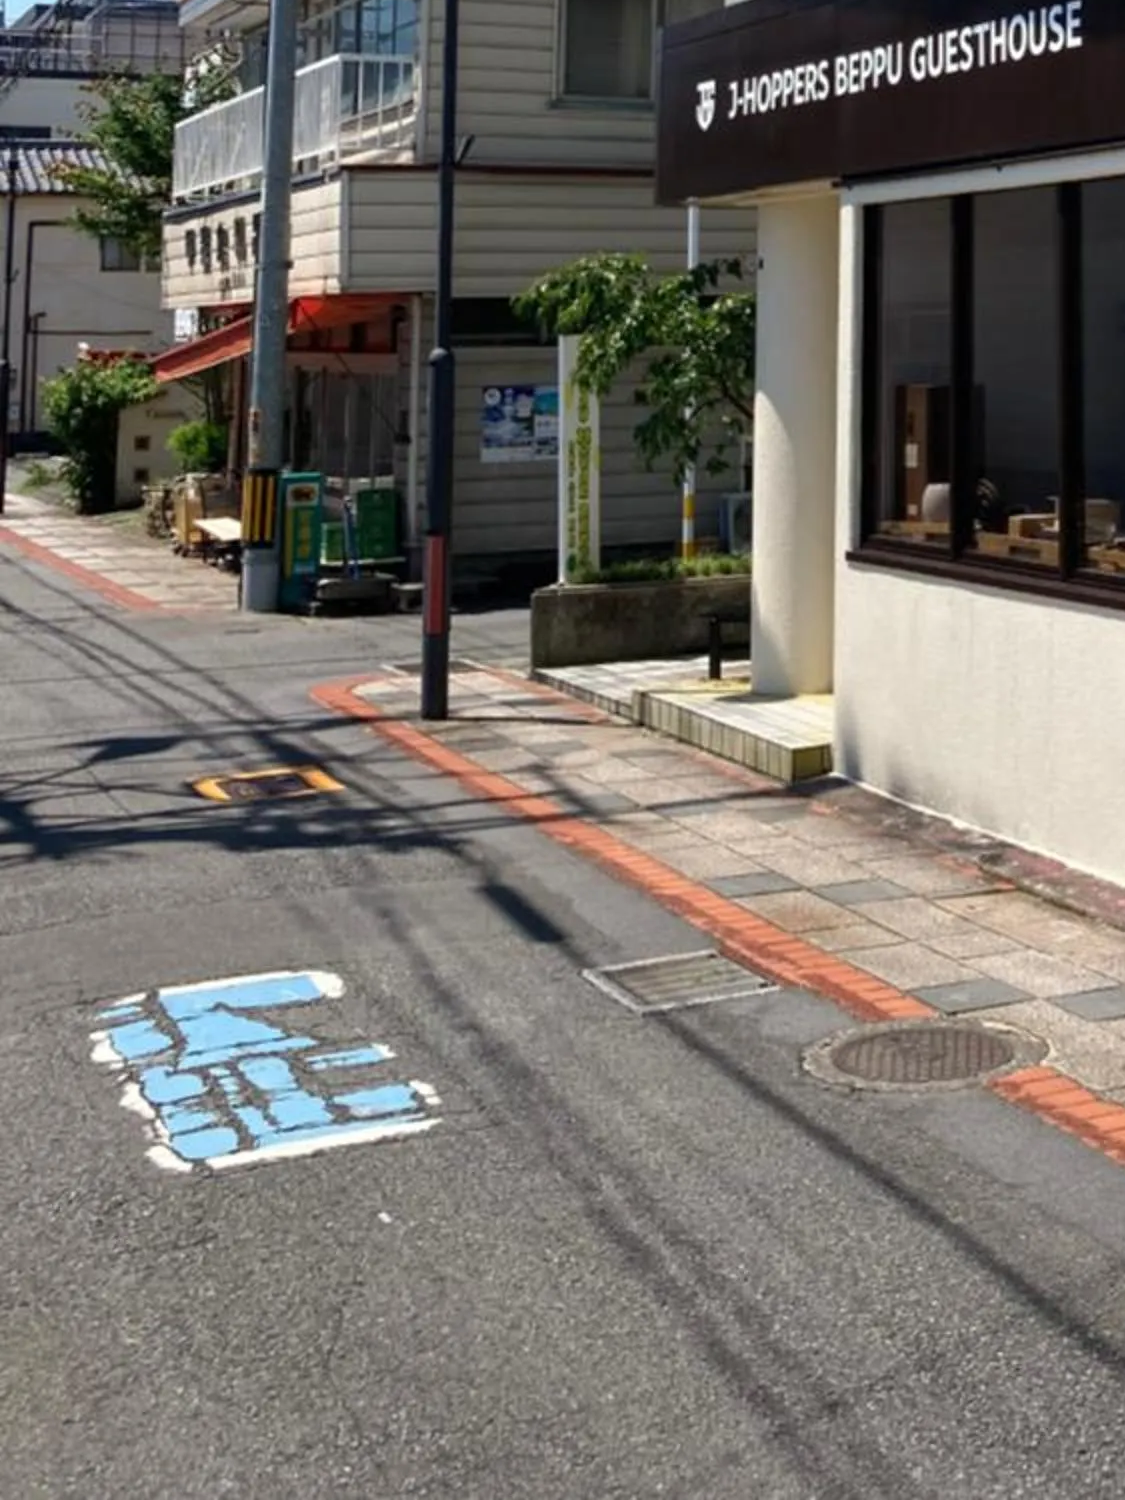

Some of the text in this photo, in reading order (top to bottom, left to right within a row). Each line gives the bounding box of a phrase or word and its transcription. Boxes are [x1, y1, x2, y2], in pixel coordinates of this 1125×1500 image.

[728, 0, 1083, 119] J-HOPPERS BEPPU GUESTHOUSE
